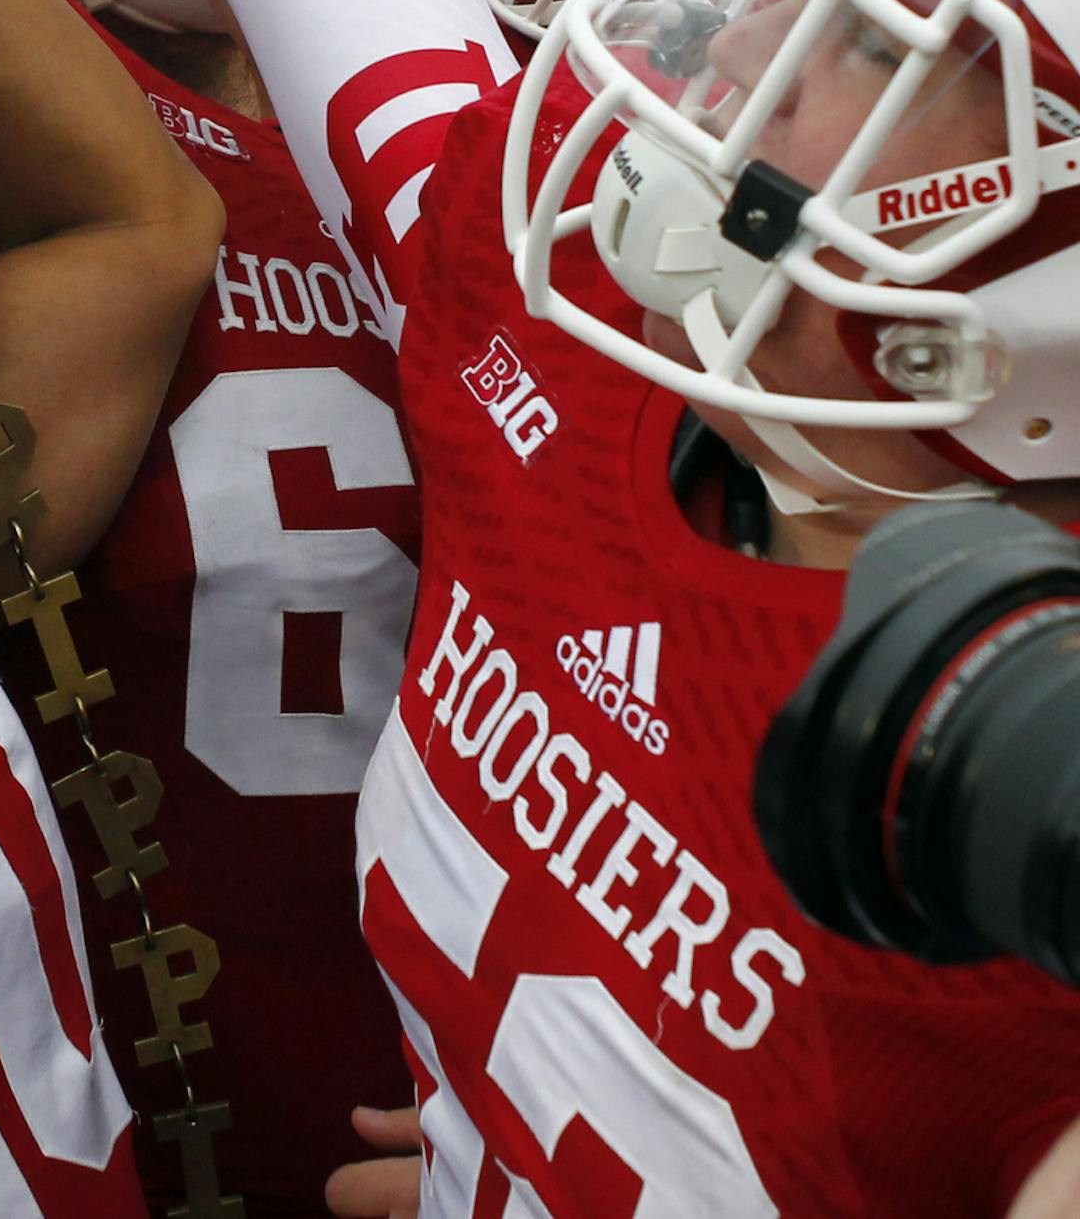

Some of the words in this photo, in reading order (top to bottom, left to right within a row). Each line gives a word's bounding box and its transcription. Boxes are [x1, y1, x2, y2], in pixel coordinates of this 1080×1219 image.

[1, 571, 115, 724] I
[168, 366, 420, 797] 6
[556, 634, 671, 757] adidas
[419, 580, 807, 1051] HOOSIERS
[110, 924, 221, 1067] P
